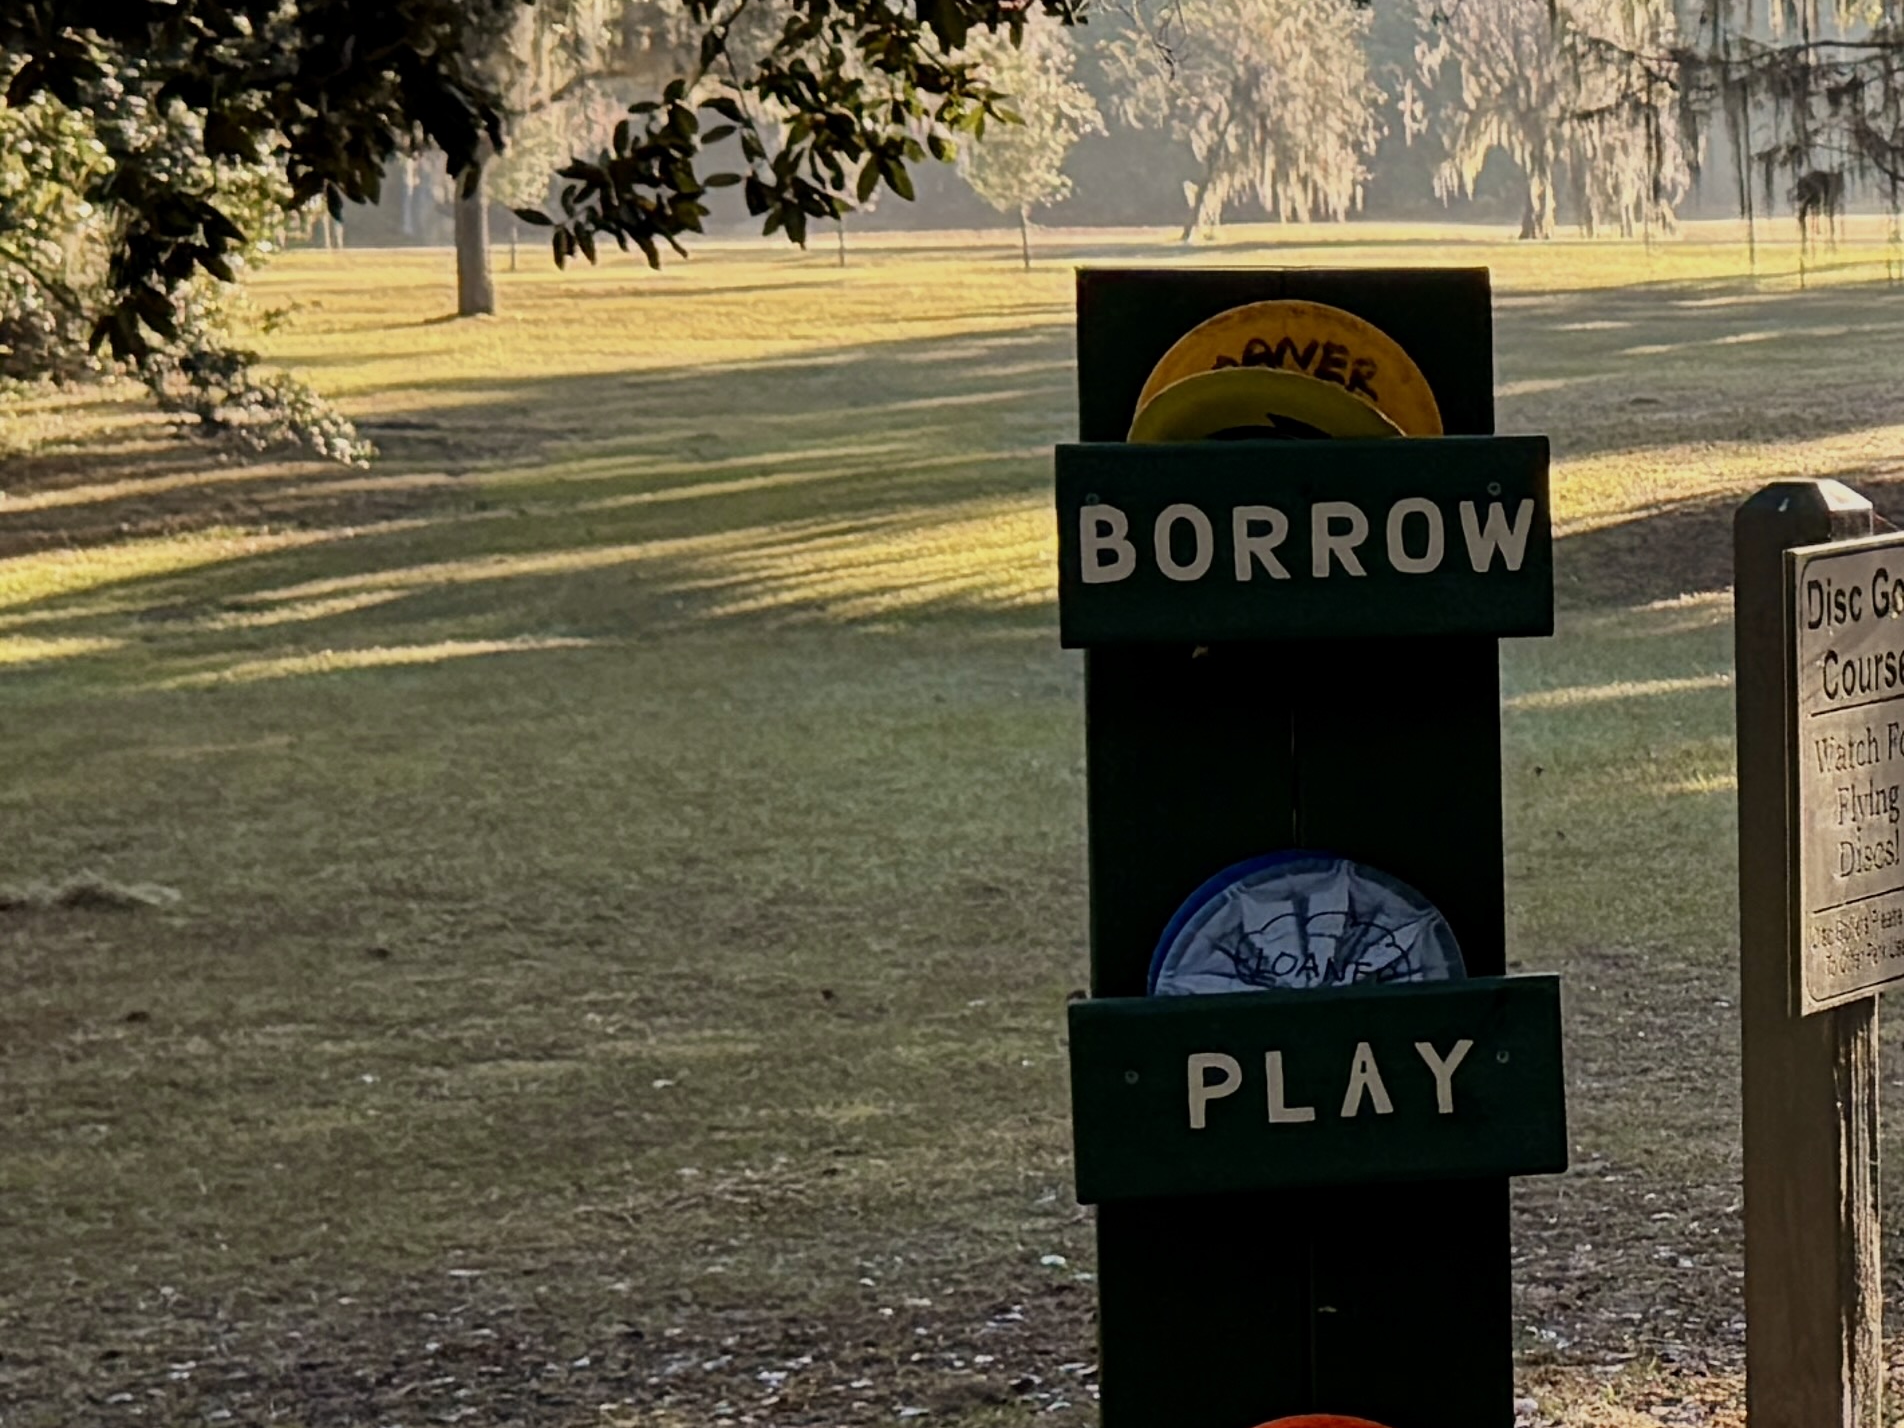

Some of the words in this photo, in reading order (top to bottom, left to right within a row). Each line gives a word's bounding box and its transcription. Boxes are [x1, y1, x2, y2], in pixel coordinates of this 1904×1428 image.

[1079, 497, 1535, 585] BORROW
[1806, 577, 1862, 630] Disc
[1815, 727, 1880, 773] Watch
[1837, 778, 1900, 825] Flying
[1840, 825, 1900, 877] Discs!
[1187, 1039, 1474, 1130] PLAY
